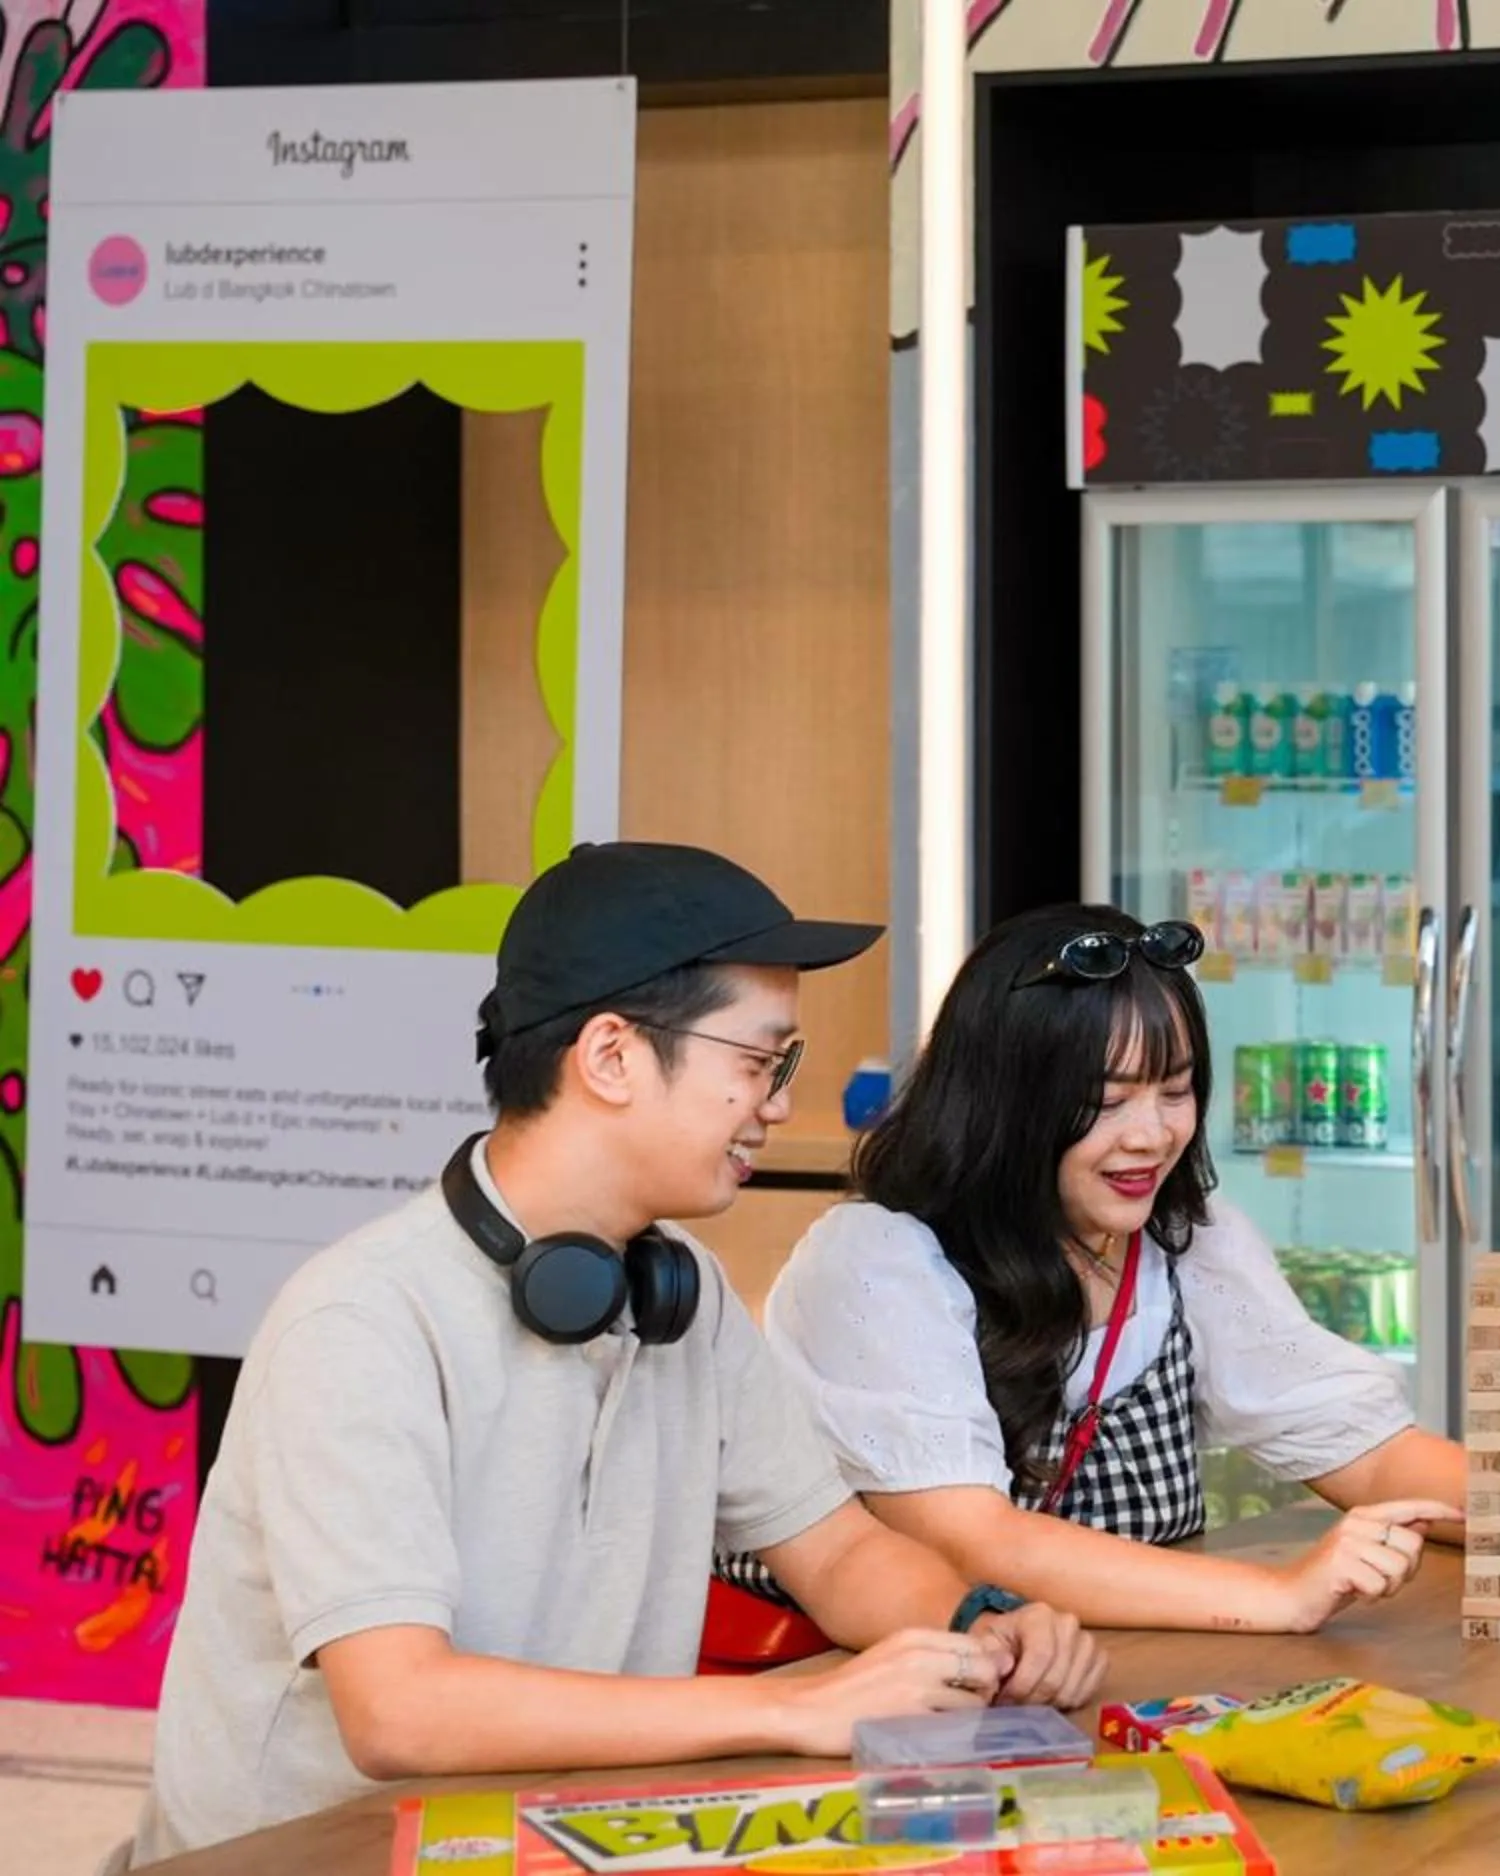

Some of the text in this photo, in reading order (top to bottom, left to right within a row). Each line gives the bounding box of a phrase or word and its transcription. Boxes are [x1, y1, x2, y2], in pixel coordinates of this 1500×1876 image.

[267, 130, 410, 178] Instagram
[165, 242, 326, 268] lubdexperience
[164, 281, 197, 300] Lub
[218, 280, 295, 302] Bangkok
[301, 279, 397, 300] Chinatown
[194, 1036, 236, 1060] likes
[67, 1074, 113, 1096] Ready
[119, 1077, 138, 1096] for
[271, 1089, 299, 1104] and
[305, 1089, 402, 1111] unforgettable
[406, 1094, 441, 1112] local
[113, 1101, 192, 1122] Chinatown
[72, 1475, 165, 1536] PING
[40, 1535, 165, 1594] HATTA
